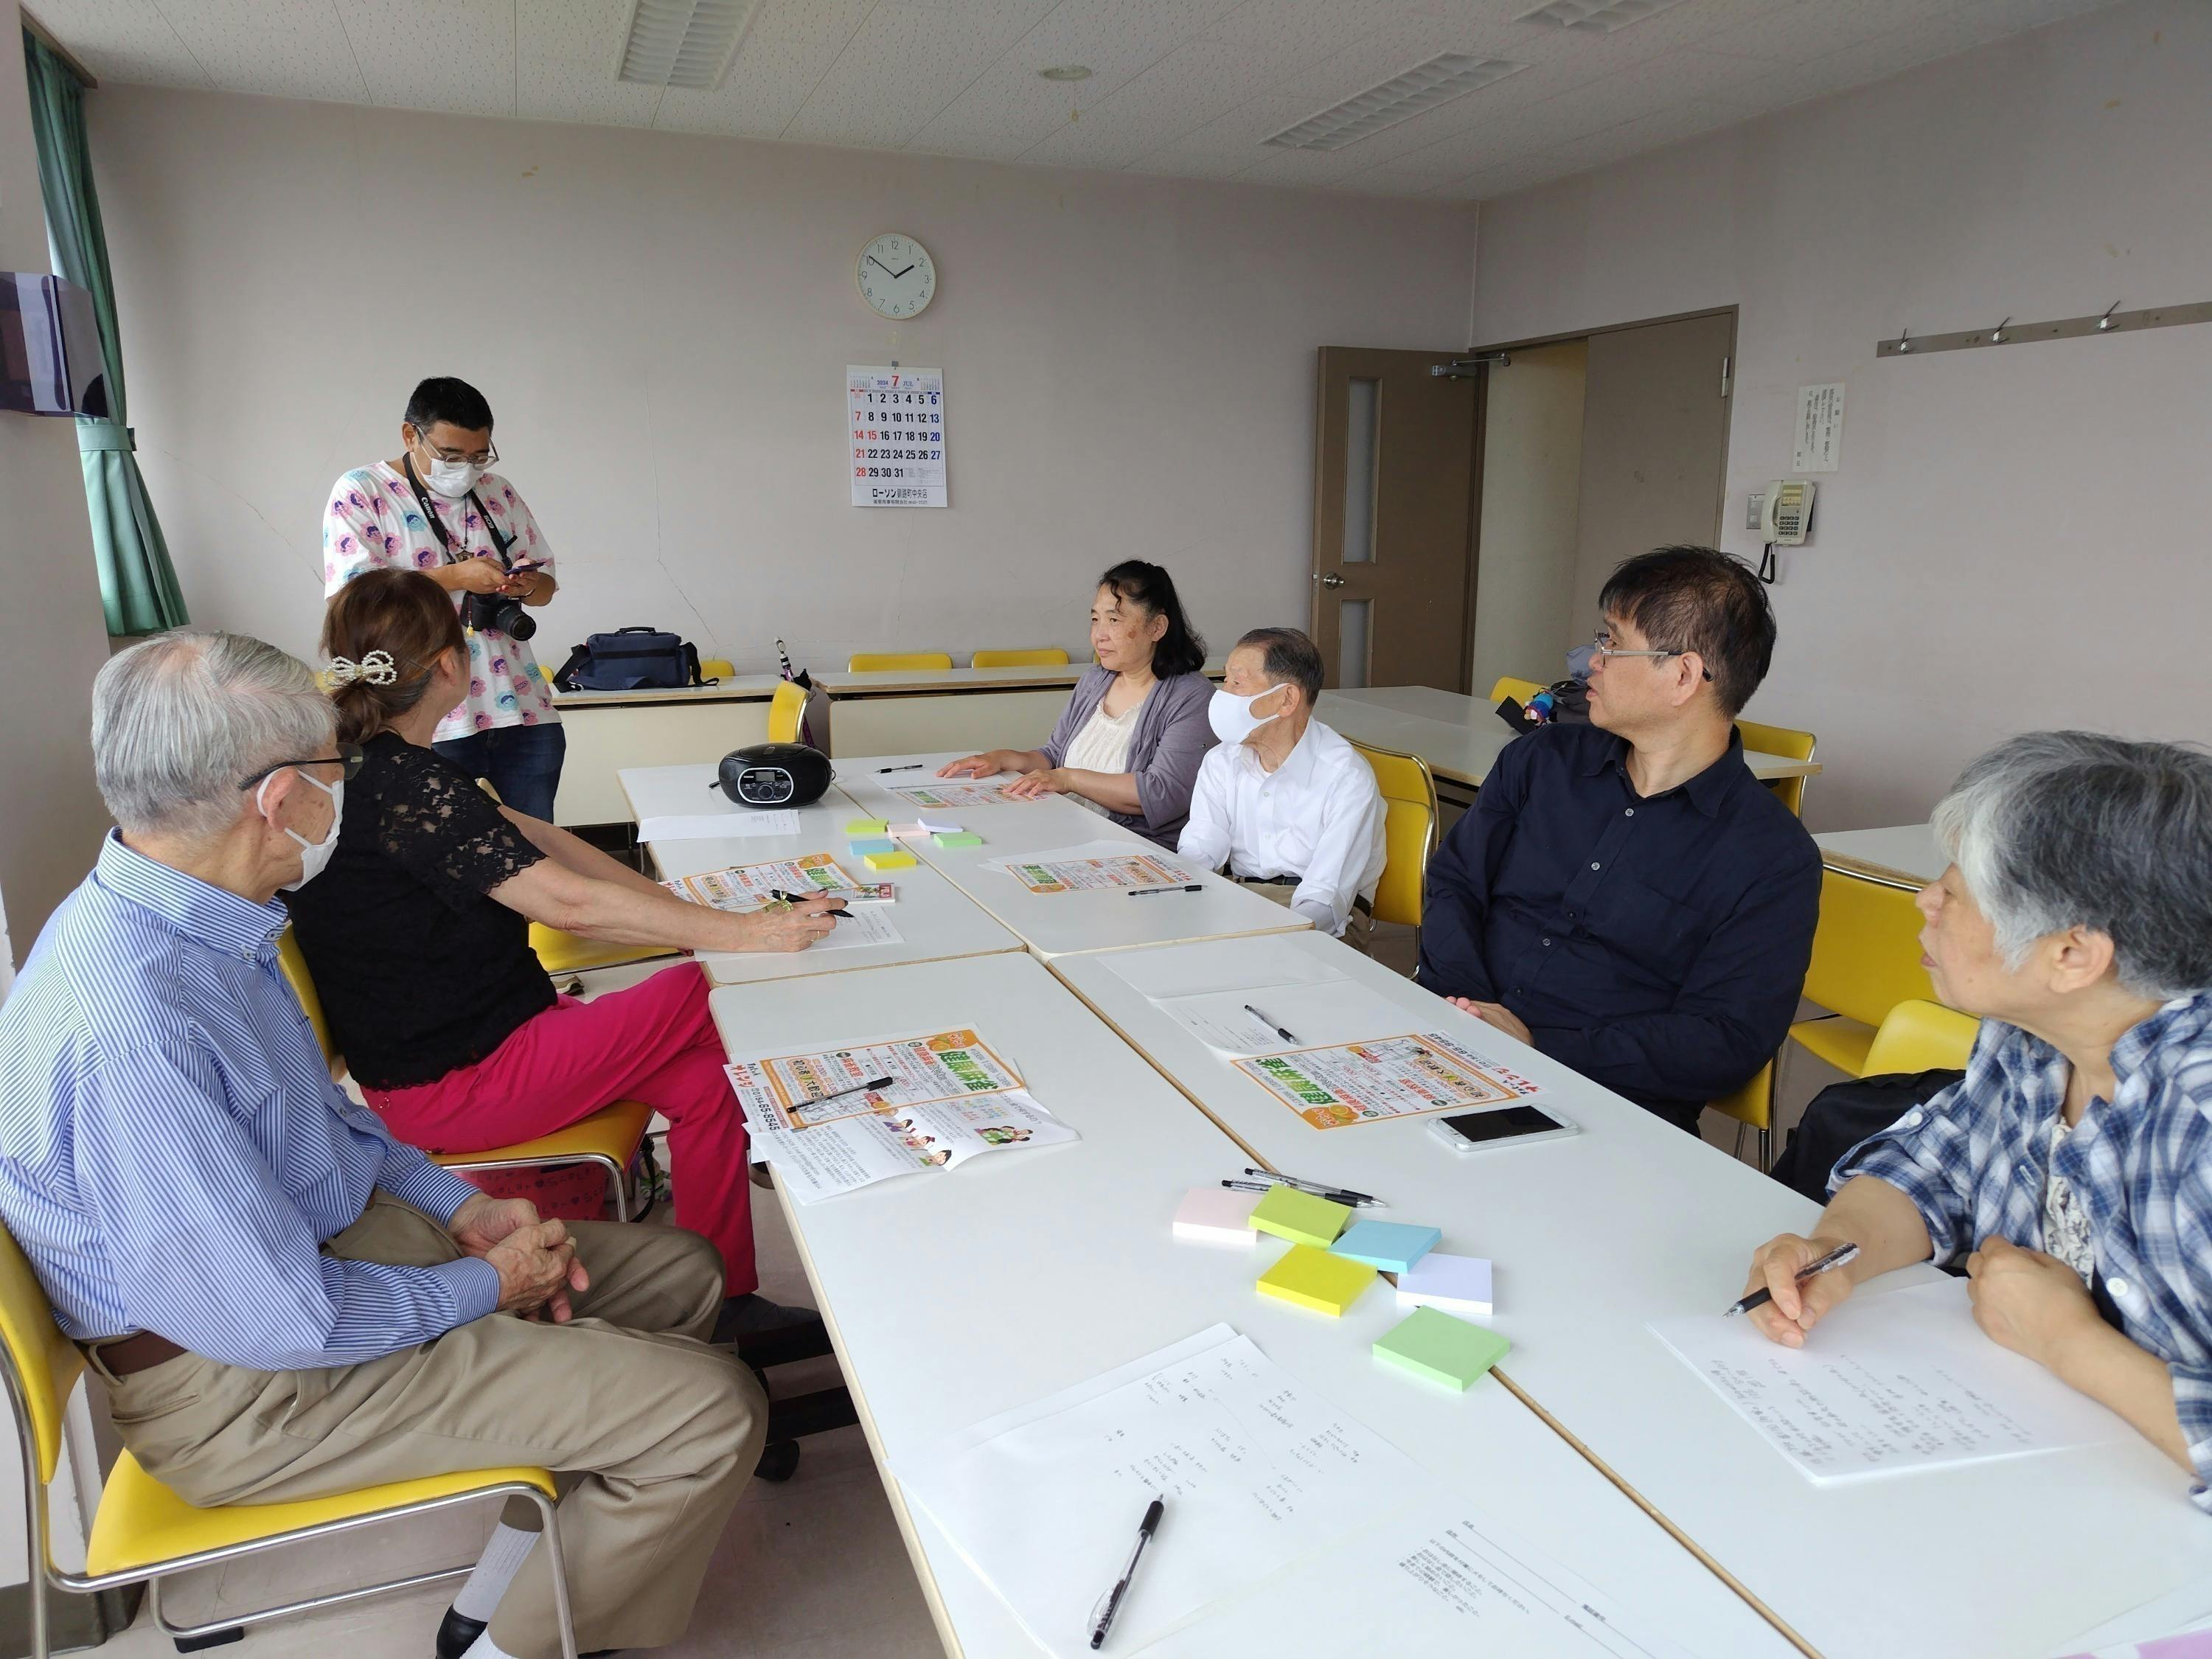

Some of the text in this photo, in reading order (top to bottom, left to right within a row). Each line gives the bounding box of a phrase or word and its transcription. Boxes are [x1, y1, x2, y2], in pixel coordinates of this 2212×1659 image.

[877, 244, 884, 254] 11
[891, 240, 899, 250] 12
[909, 245, 911, 255] 1
[866, 256, 874, 266] 10
[919, 257, 924, 267] 2
[862, 271, 867, 281] 9
[924, 275, 930, 284] 3
[867, 288, 873, 297] 8
[919, 290, 925, 299] 4
[879, 299, 885, 309] 7
[893, 305, 900, 313] 6
[909, 300, 914, 310] 5
[892, 375, 899, 387] 7
[868, 393, 937, 405] 1 2 3 4 5 6
[855, 411, 939, 423] 7 8 9 10 11 12 13
[854, 430, 940, 442] 14 15 16 17 18 19 20
[856, 449, 941, 460] 21 22 23 24 25 26 27
[856, 467, 866, 477] 28
[869, 468, 879, 477] 29
[881, 468, 891, 477] 30
[894, 468, 903, 478] 31
[421, 497, 435, 518] Canon
[936, 1051, 998, 1091] 健康麻雀
[730, 1065, 755, 1088] オレンジ
[1255, 1057, 1340, 1105] 健康麻雀
[1493, 1067, 1540, 1094] オレンジ
